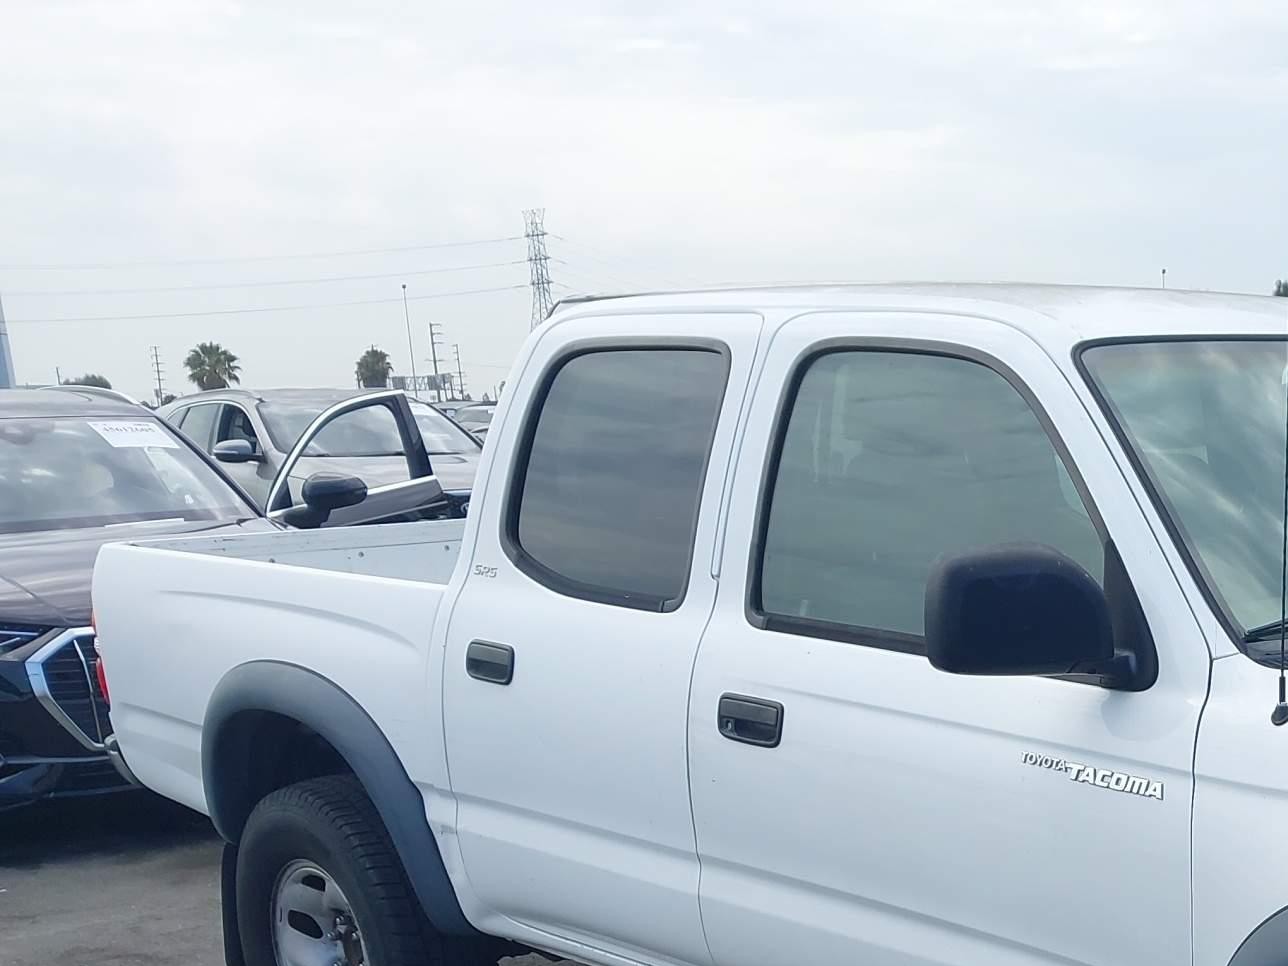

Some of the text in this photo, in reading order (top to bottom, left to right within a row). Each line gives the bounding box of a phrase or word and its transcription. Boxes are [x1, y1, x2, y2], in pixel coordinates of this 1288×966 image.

[473, 564, 498, 578] SR5
[1021, 751, 1165, 800] TOYOTA TACOMA
